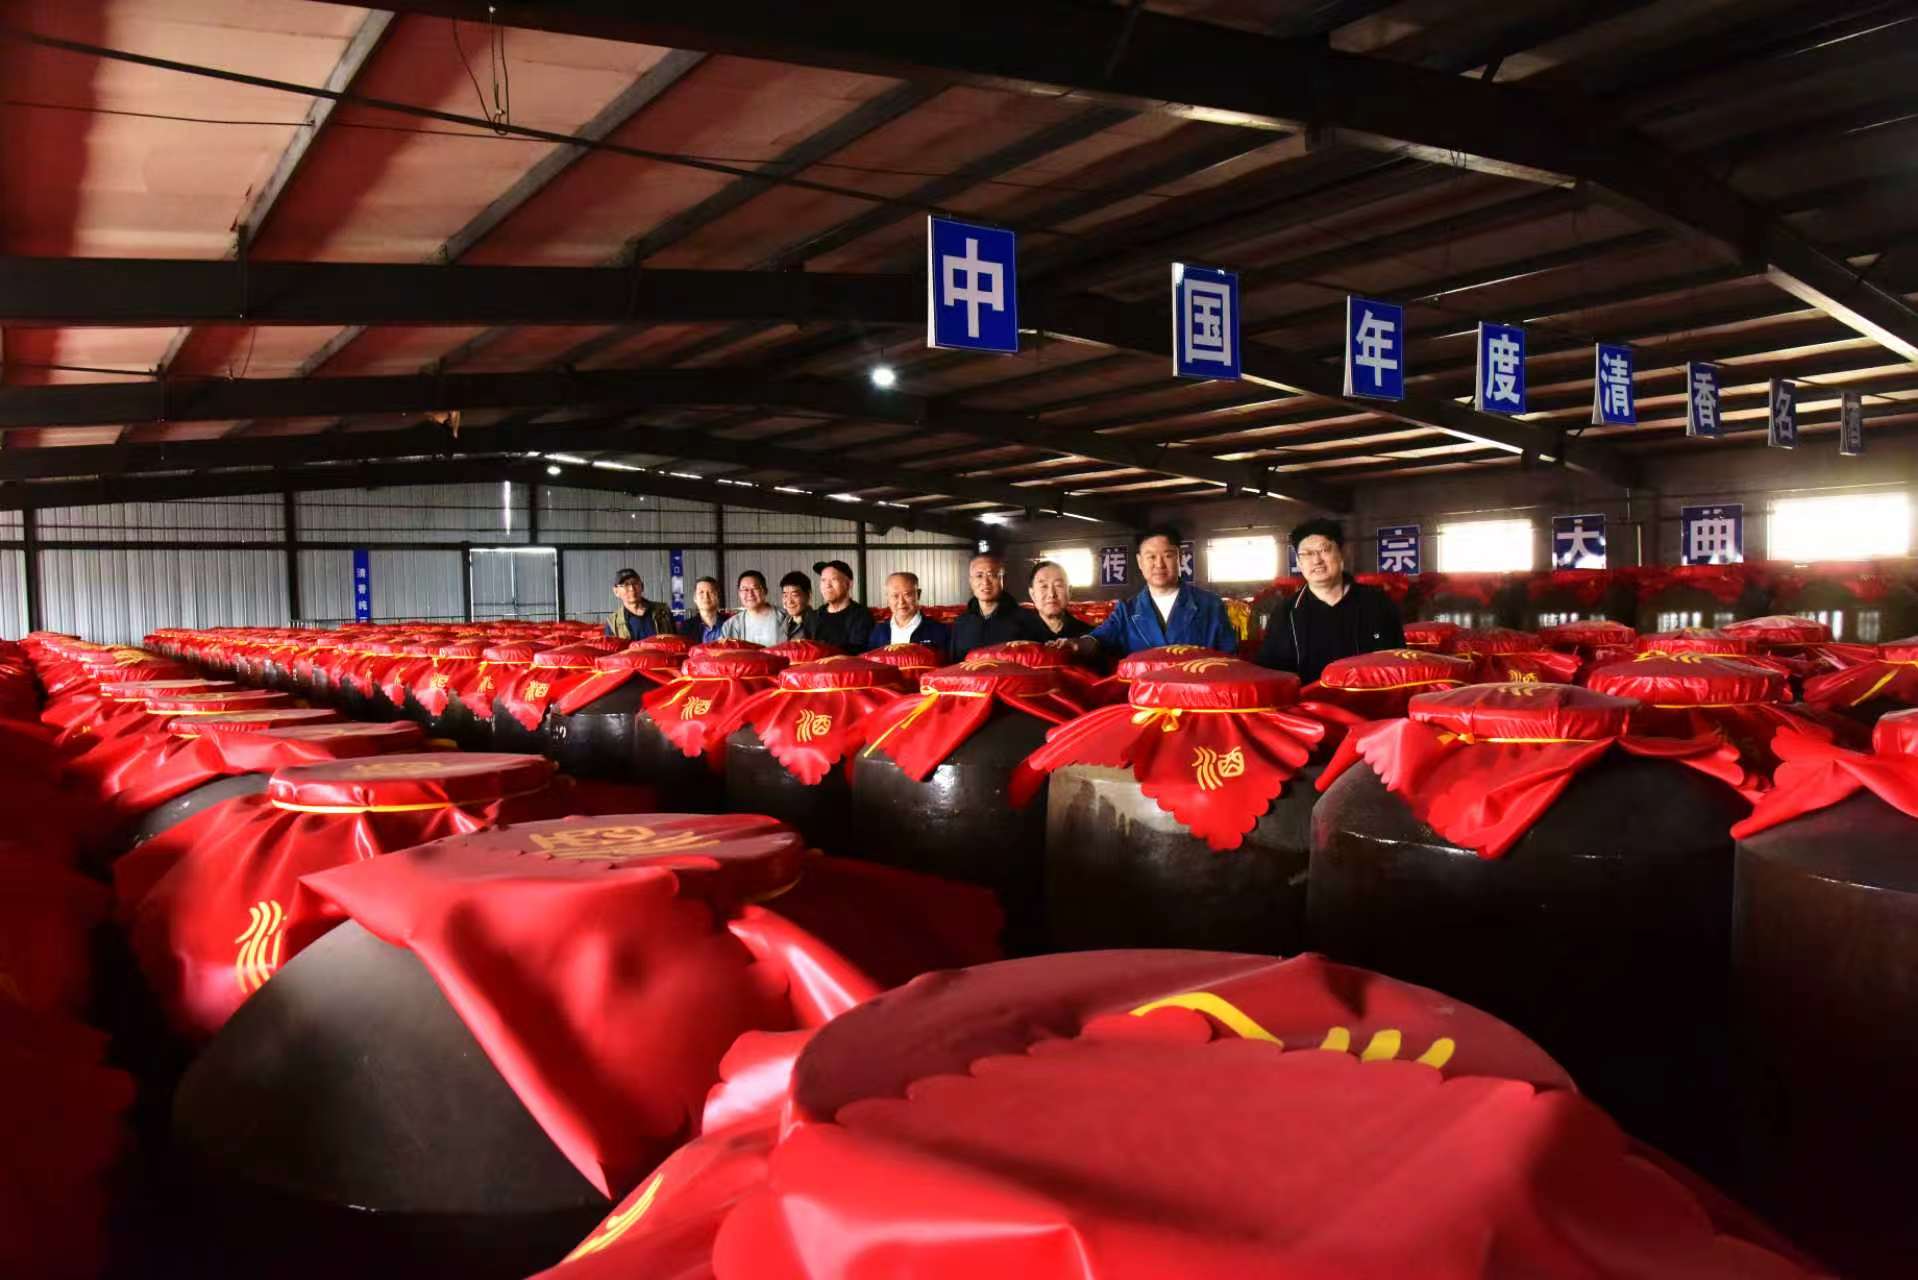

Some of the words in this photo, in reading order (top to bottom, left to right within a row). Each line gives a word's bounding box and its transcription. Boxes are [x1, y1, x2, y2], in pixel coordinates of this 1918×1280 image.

[943, 237, 1005, 338] 中
[1184, 278, 1232, 367] 国
[1355, 309, 1399, 387] 年
[1485, 334, 1521, 405] 度
[1600, 353, 1631, 418] 清
[1693, 372, 1717, 430] 香
[1775, 383, 1793, 440] 名
[1381, 529, 1416, 572] 宗
[1557, 518, 1601, 568] 大
[1690, 508, 1736, 562] 曲
[1102, 548, 1126, 583] 传
[680, 696, 711, 720] 酒
[796, 709, 832, 742] 酒
[1192, 746, 1245, 791] 酒
